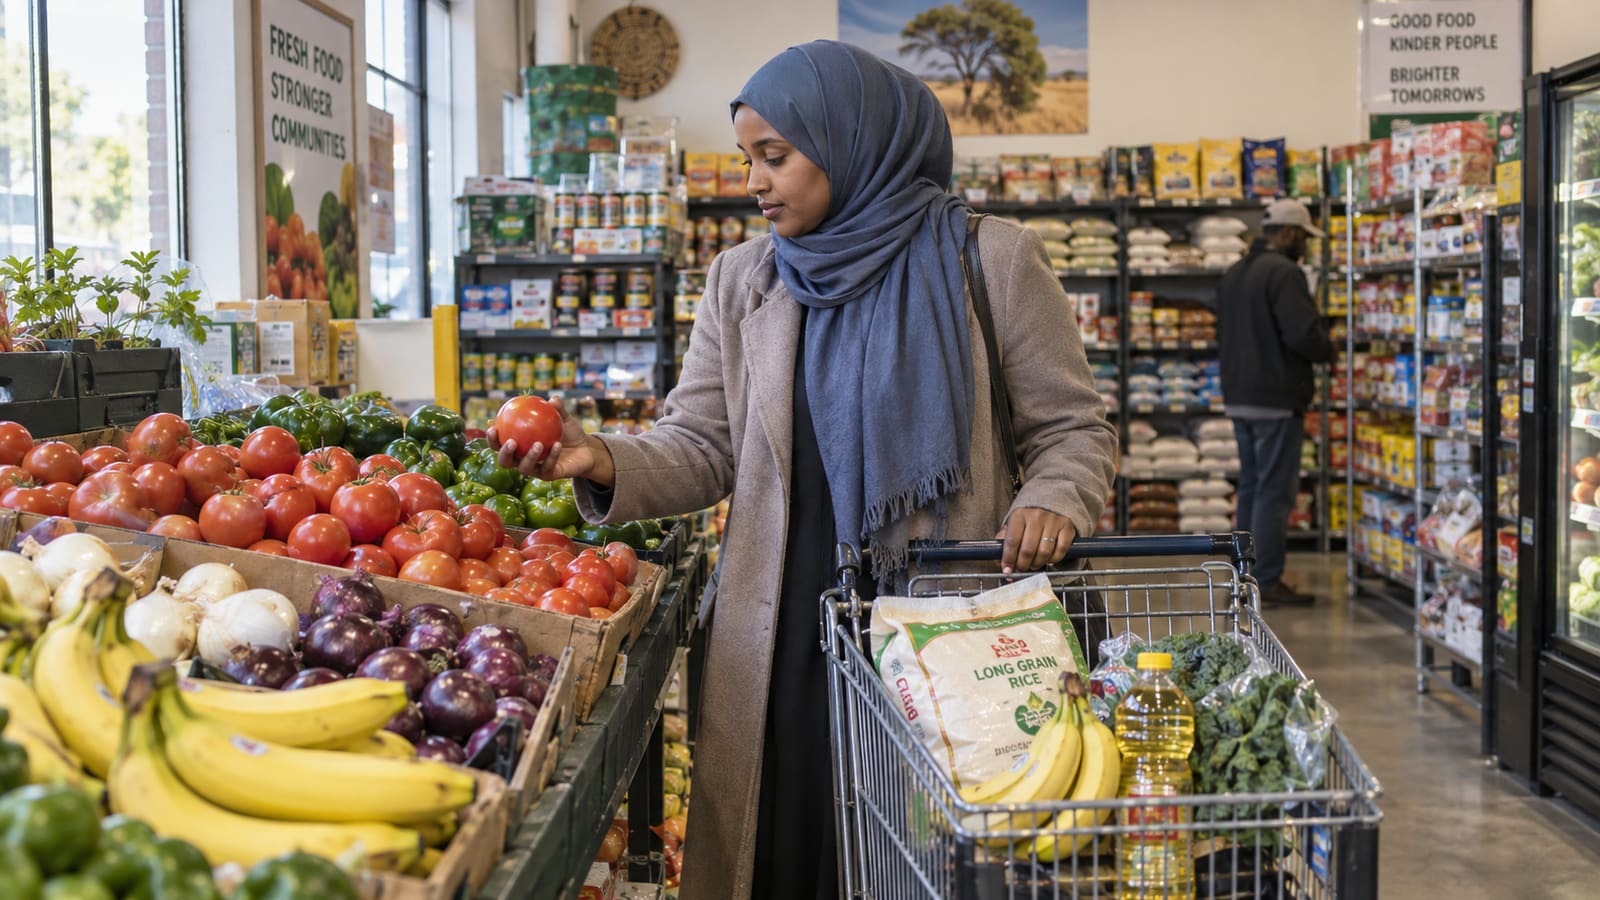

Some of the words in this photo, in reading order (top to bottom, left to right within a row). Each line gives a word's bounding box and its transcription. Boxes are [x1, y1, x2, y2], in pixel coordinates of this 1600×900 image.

[1390, 13, 1432, 29] GOOD
[1436, 12, 1476, 28] FOOD
[1390, 35, 1441, 51] KINDER
[1445, 33, 1498, 50] PEOPLE
[270, 24, 309, 70] FRESH
[313, 45, 344, 84] FOOD
[1390, 66, 1460, 83] BRIGHTER
[271, 71, 333, 119] STRONGER
[1390, 87, 1486, 103] TOMORROWS
[272, 113, 346, 160] COMMUNITIES
[973, 663, 1015, 681] LONG
[1016, 656, 1058, 672] GRAIN
[1008, 673, 1042, 689] RICE
